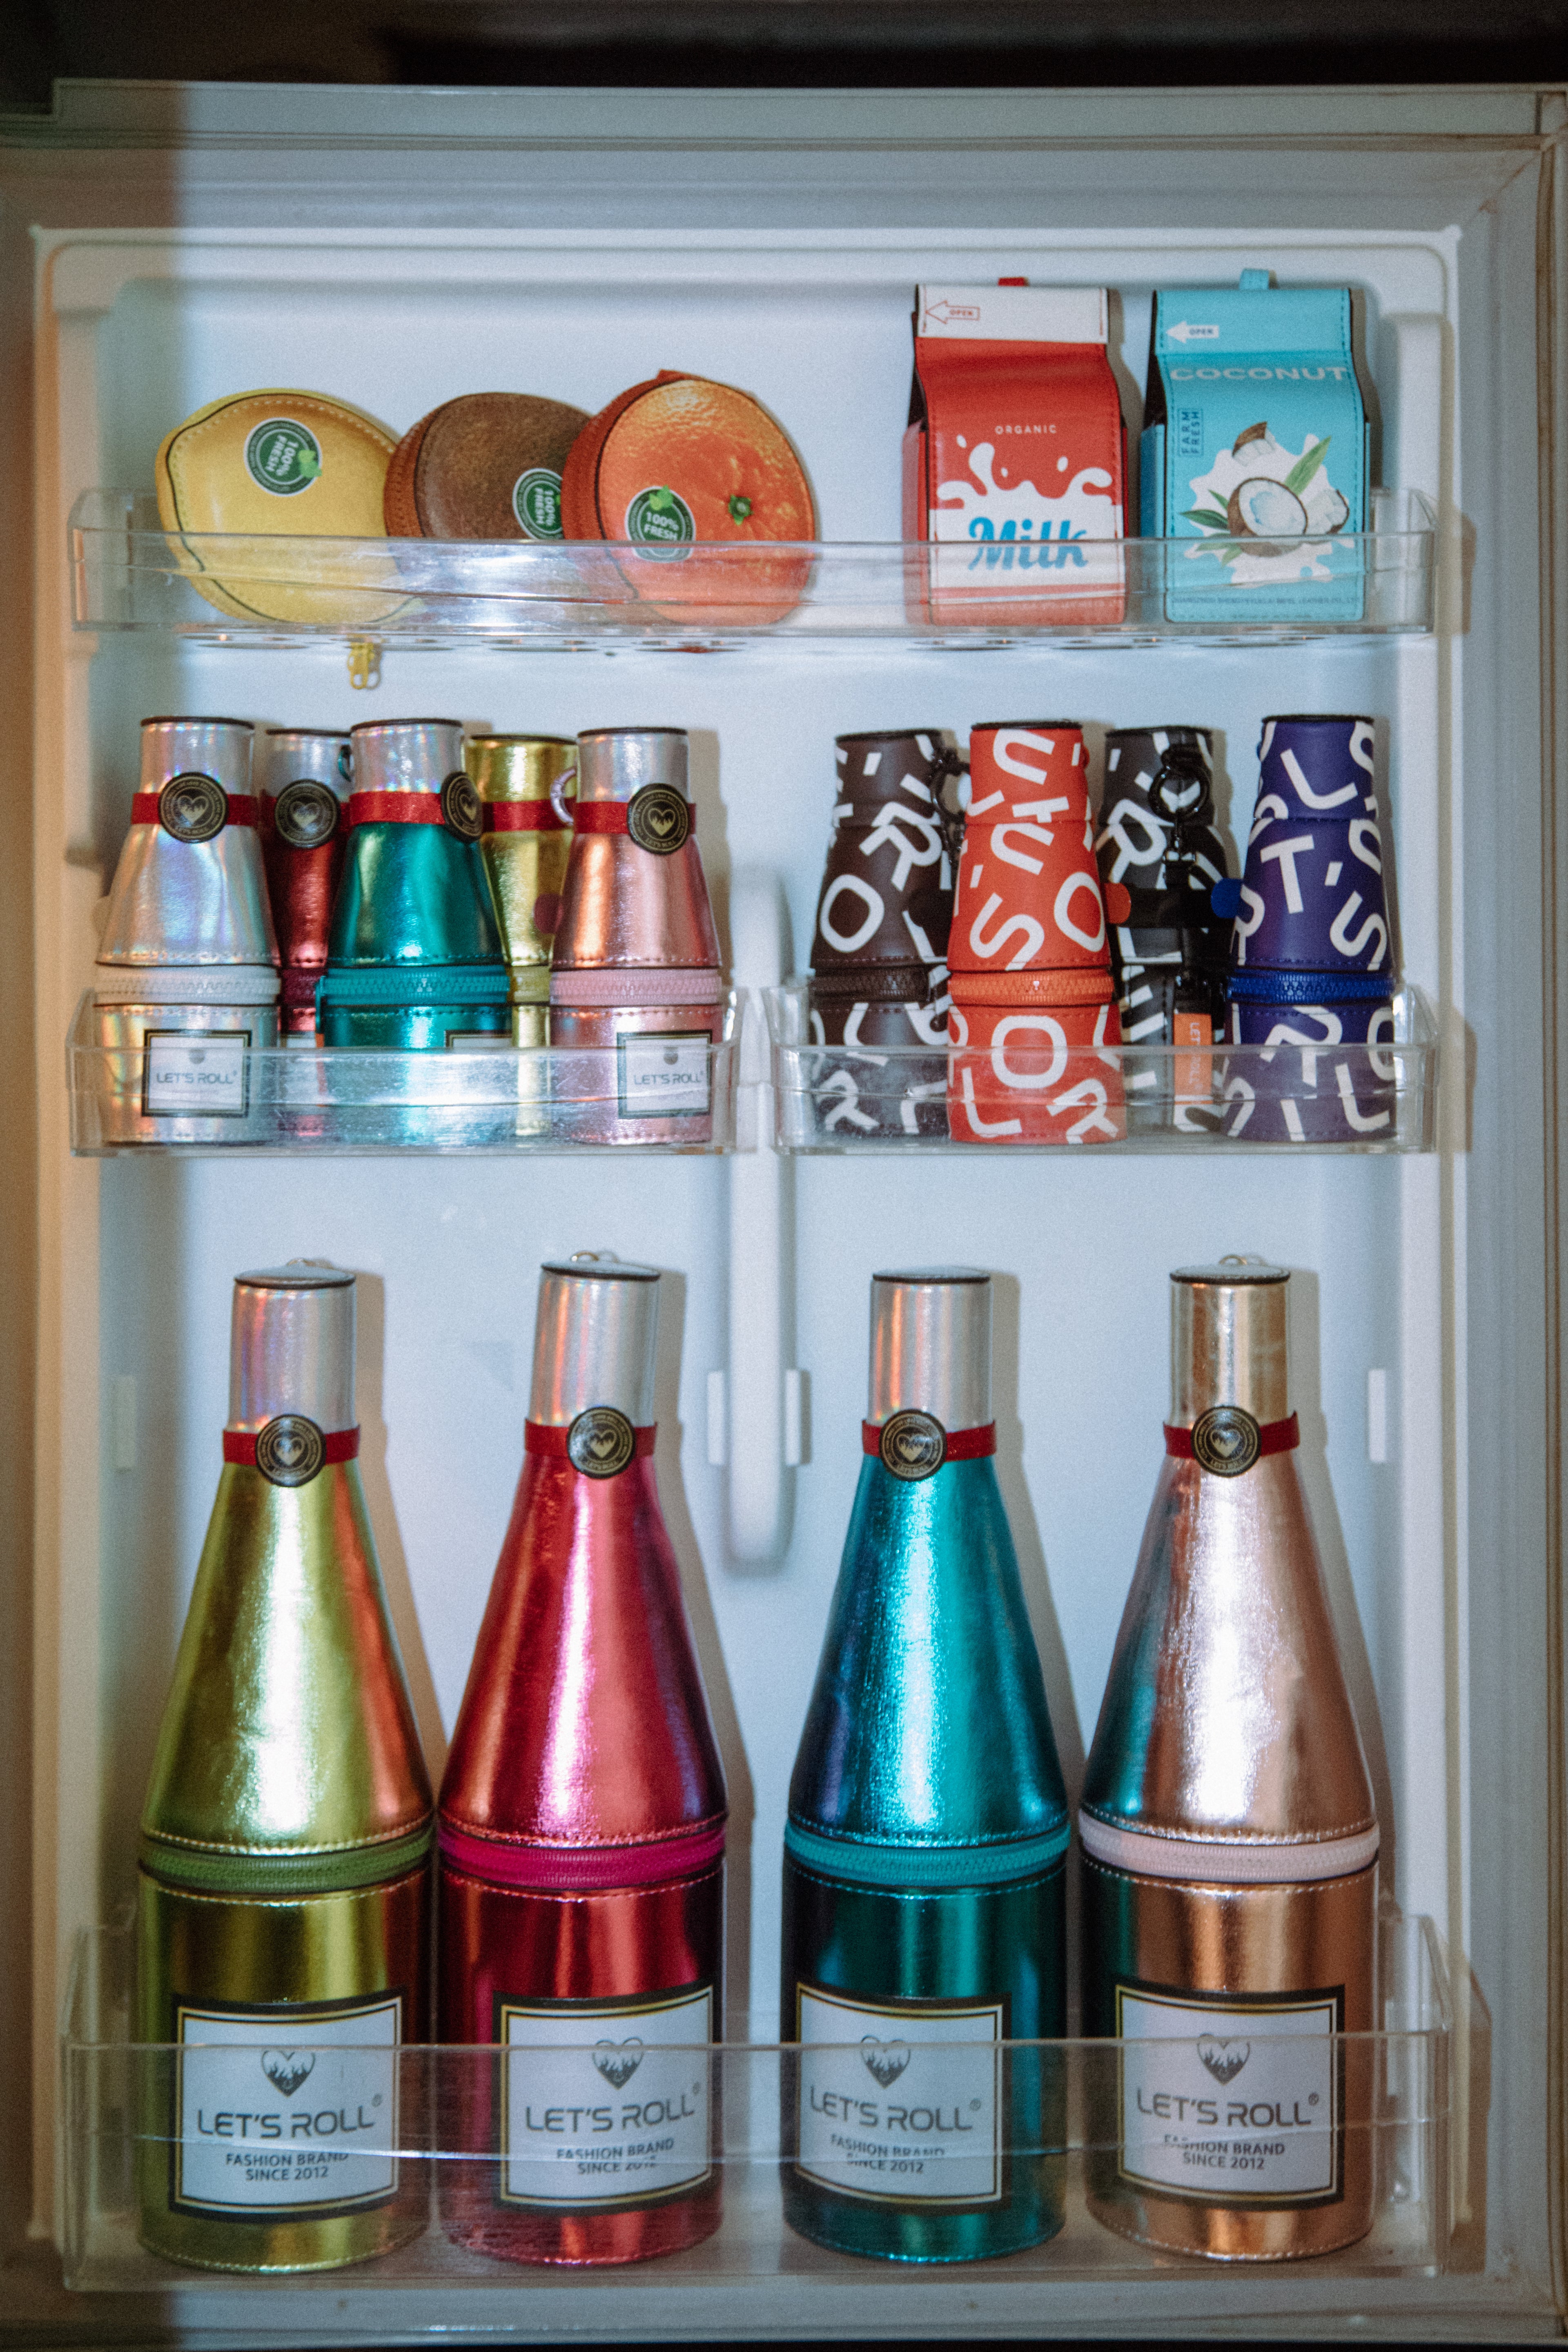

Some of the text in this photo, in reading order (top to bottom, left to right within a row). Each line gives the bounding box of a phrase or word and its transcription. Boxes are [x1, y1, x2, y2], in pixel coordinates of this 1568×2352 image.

[1170, 367, 1348, 381] COCONUT
[995, 425, 1058, 435] ORGANIC
[1182, 411, 1190, 454] FARM
[1191, 411, 1200, 454] FRESH
[646, 511, 679, 531] 100%
[644, 523, 678, 541] FRESH
[968, 517, 1089, 571] Milk
[156, 1072, 233, 1084] LET'S ROLL
[634, 1073, 701, 1085] LET'S ROLL
[526, 2094, 694, 2133] LET'S ROLL
[810, 2084, 973, 2132] LET'S ROLL
[1136, 2087, 1311, 2127] LET'S ROLL
[198, 2105, 375, 2138] LET'S ROLL
[557, 2137, 674, 2159] FASHION BRAND
[831, 2134, 888, 2157] FASHION
[1233, 2143, 1285, 2155] BRAND
[226, 2152, 348, 2167] FASHION BRAND
[578, 2162, 621, 2174] SINCE
[890, 2160, 924, 2174] 2012
[1183, 2152, 1265, 2170] SINCE 2012
[245, 2166, 328, 2181] SINCE 2012
